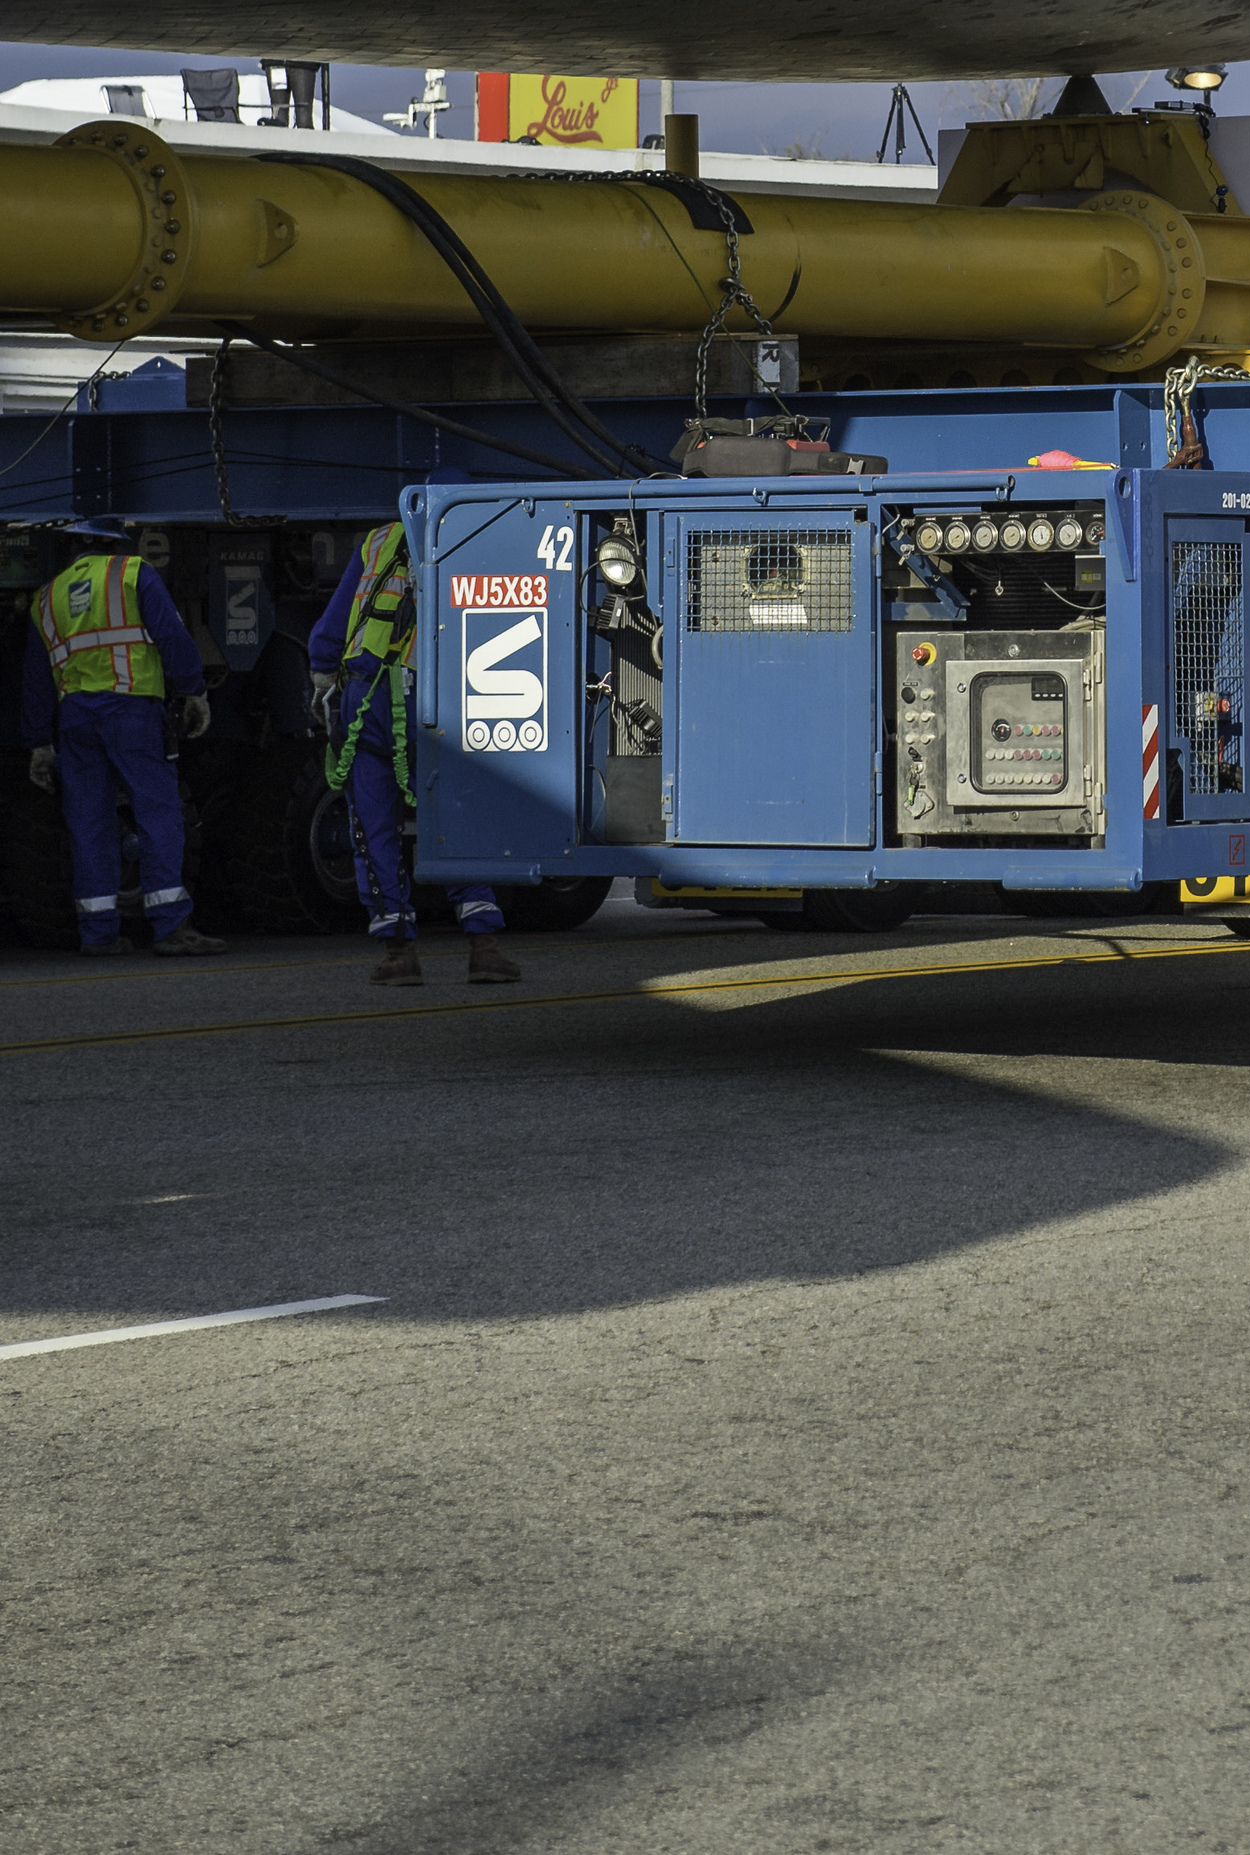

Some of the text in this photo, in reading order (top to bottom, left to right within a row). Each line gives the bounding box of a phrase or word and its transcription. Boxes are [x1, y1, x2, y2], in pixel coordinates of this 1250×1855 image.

[527, 74, 604, 144] Louis
[219, 550, 265, 562] KAMAG
[536, 525, 575, 572] 42
[452, 576, 548, 606] WJ5X83
